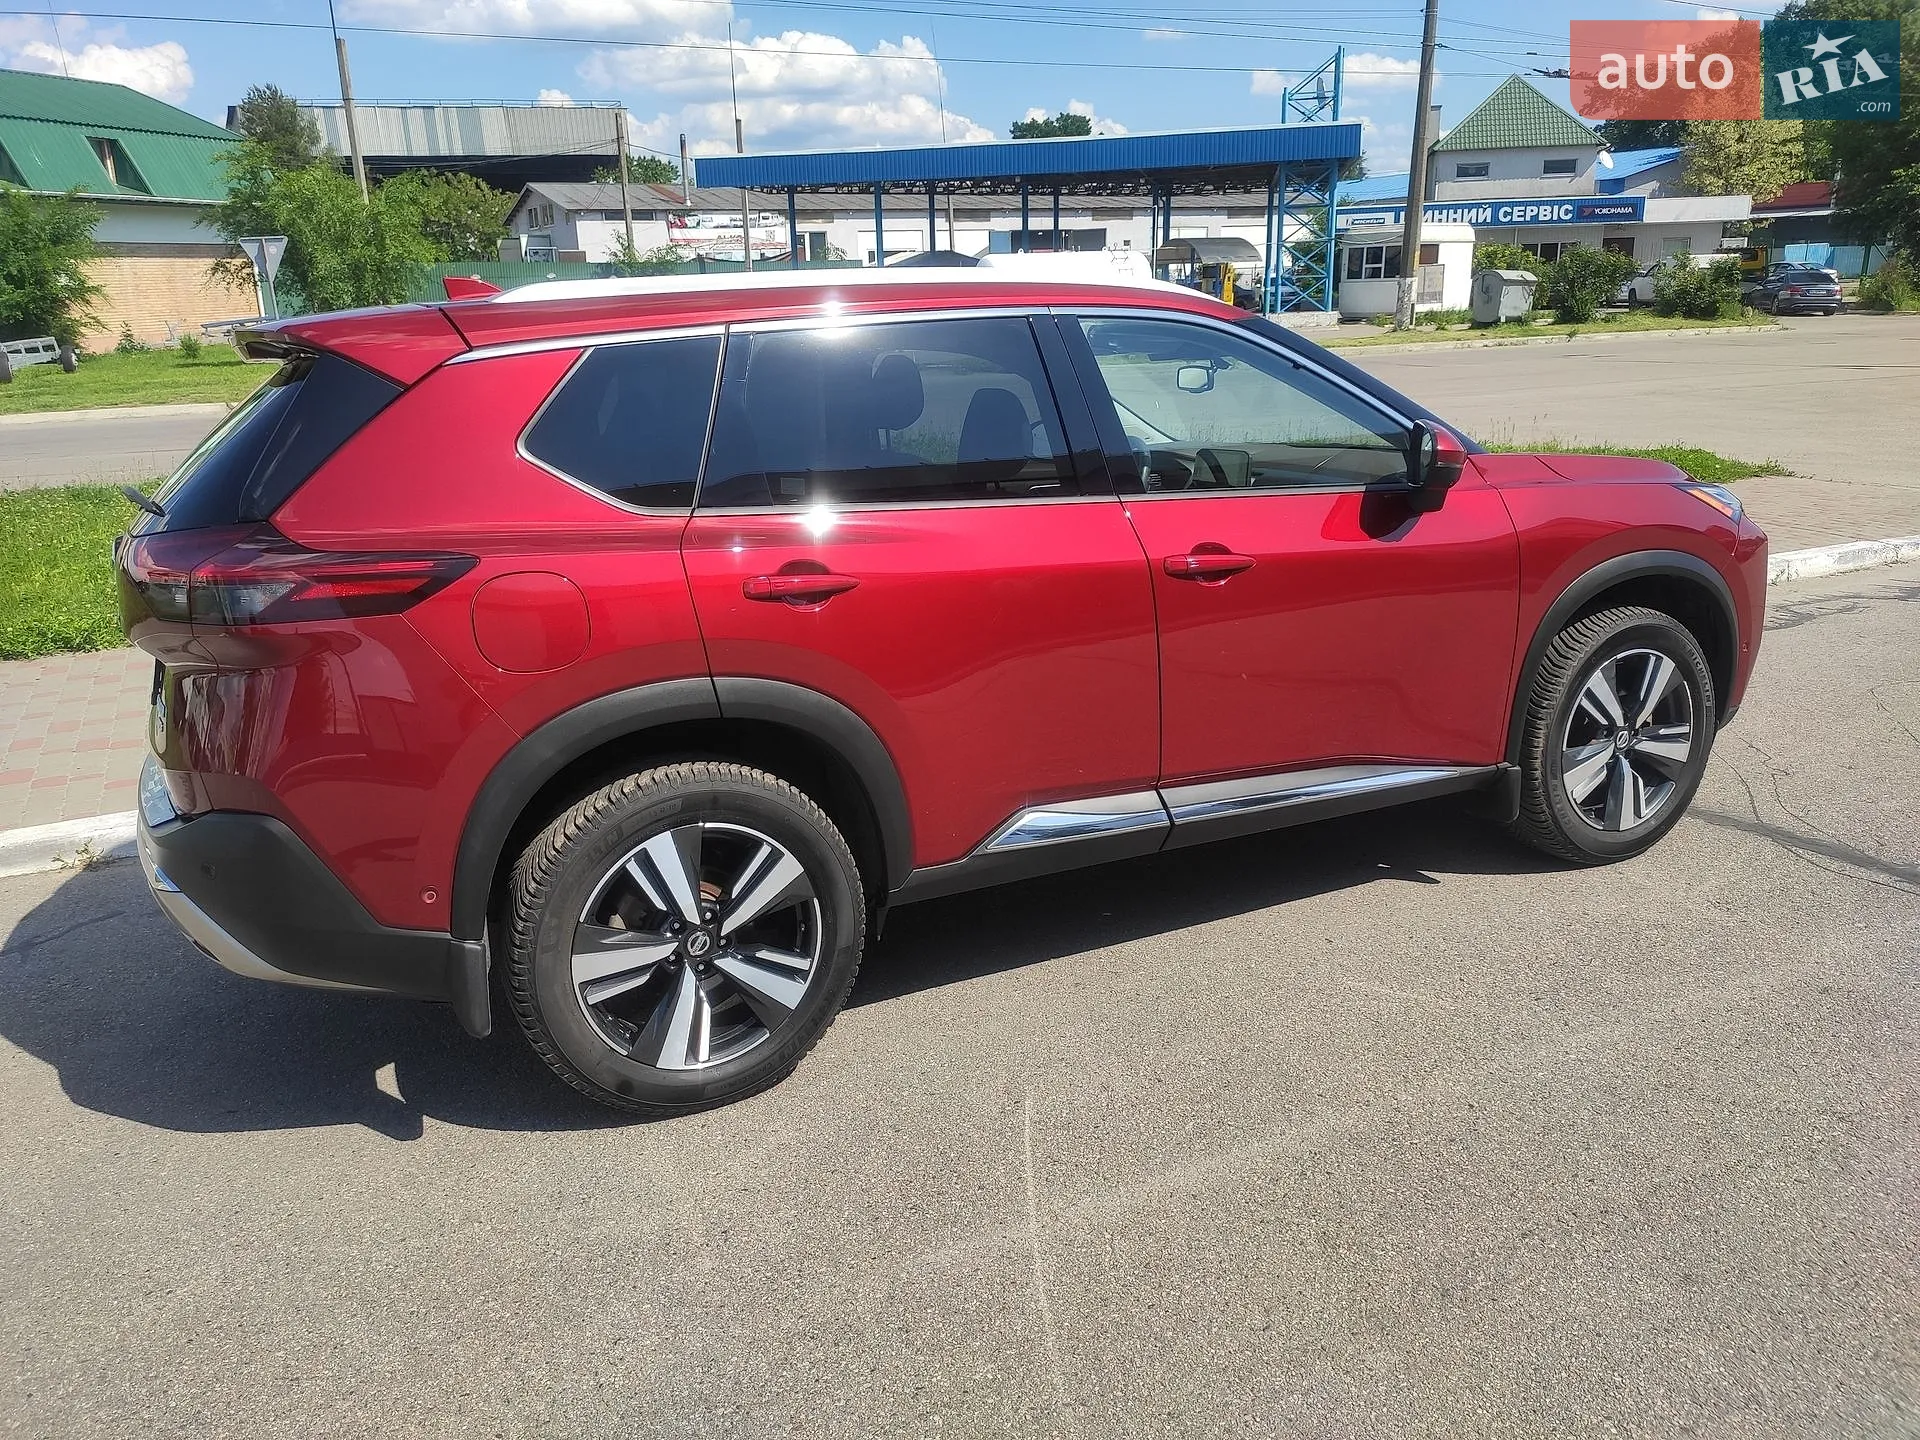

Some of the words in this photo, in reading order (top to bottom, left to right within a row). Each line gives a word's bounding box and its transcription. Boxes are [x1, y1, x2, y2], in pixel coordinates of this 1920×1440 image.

[1399, 204, 1492, 223] ИННИЙ
[1498, 204, 1574, 222] СЕРВІС
[1593, 206, 1633, 215] YOKOHAMA
